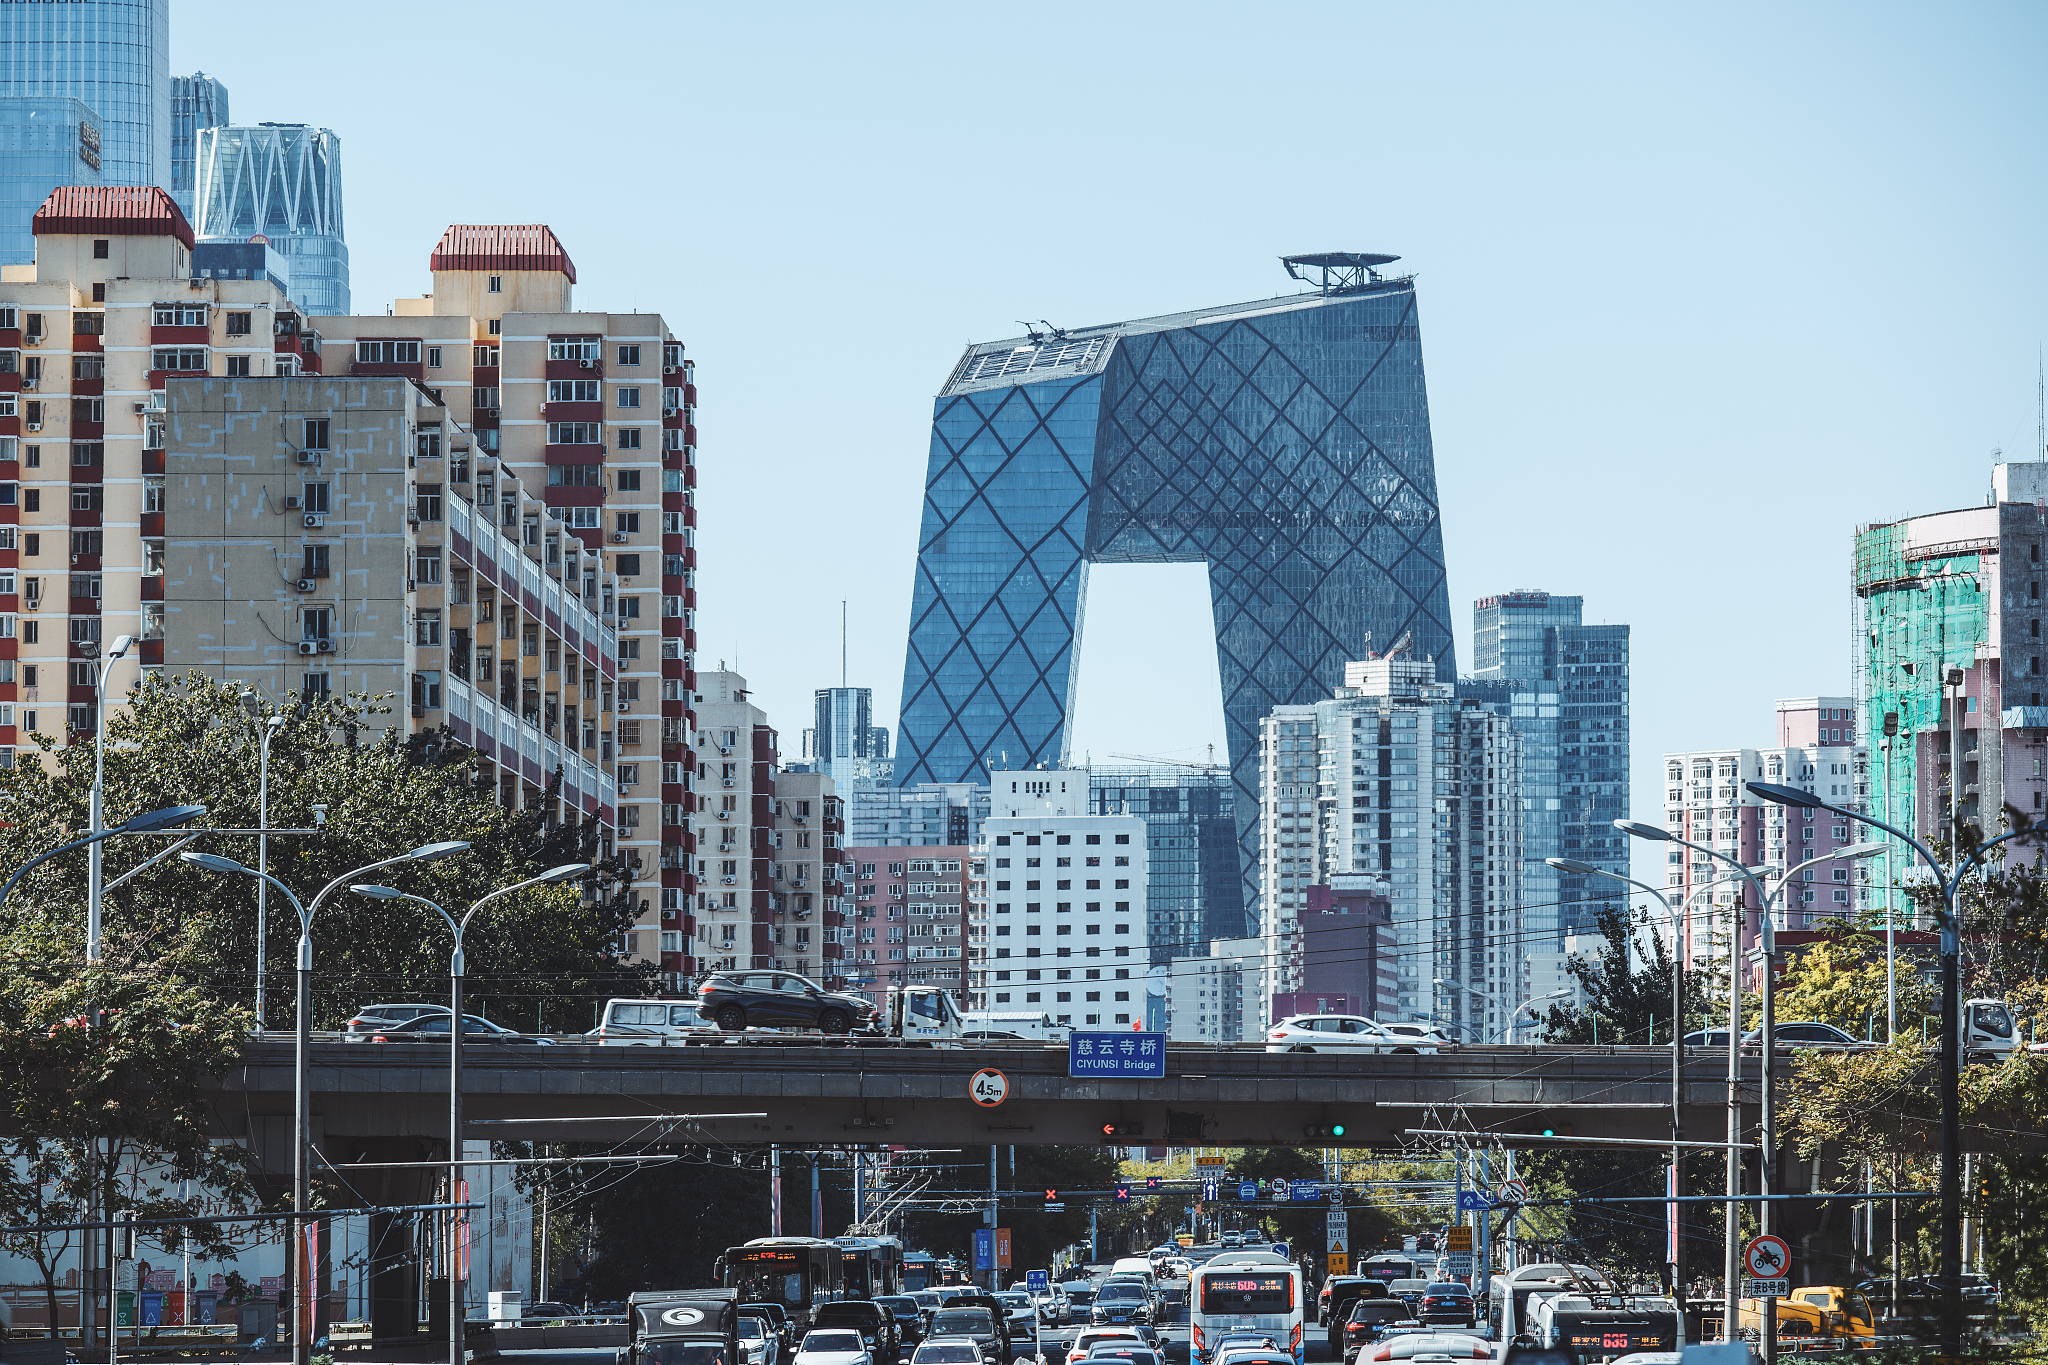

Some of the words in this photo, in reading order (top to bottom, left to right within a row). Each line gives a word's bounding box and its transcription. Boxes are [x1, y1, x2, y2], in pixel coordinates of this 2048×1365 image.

[1077, 1039, 1157, 1056] 慈云寺桥
[1076, 1059, 1119, 1069] CIYUNSI
[1124, 1059, 1156, 1071] Bridge
[976, 1080, 1002, 1096] 4.5m
[1237, 1280, 1257, 1291] 605
[1753, 1281, 1787, 1294] 京B号牌
[1602, 1333, 1628, 1348] 635
